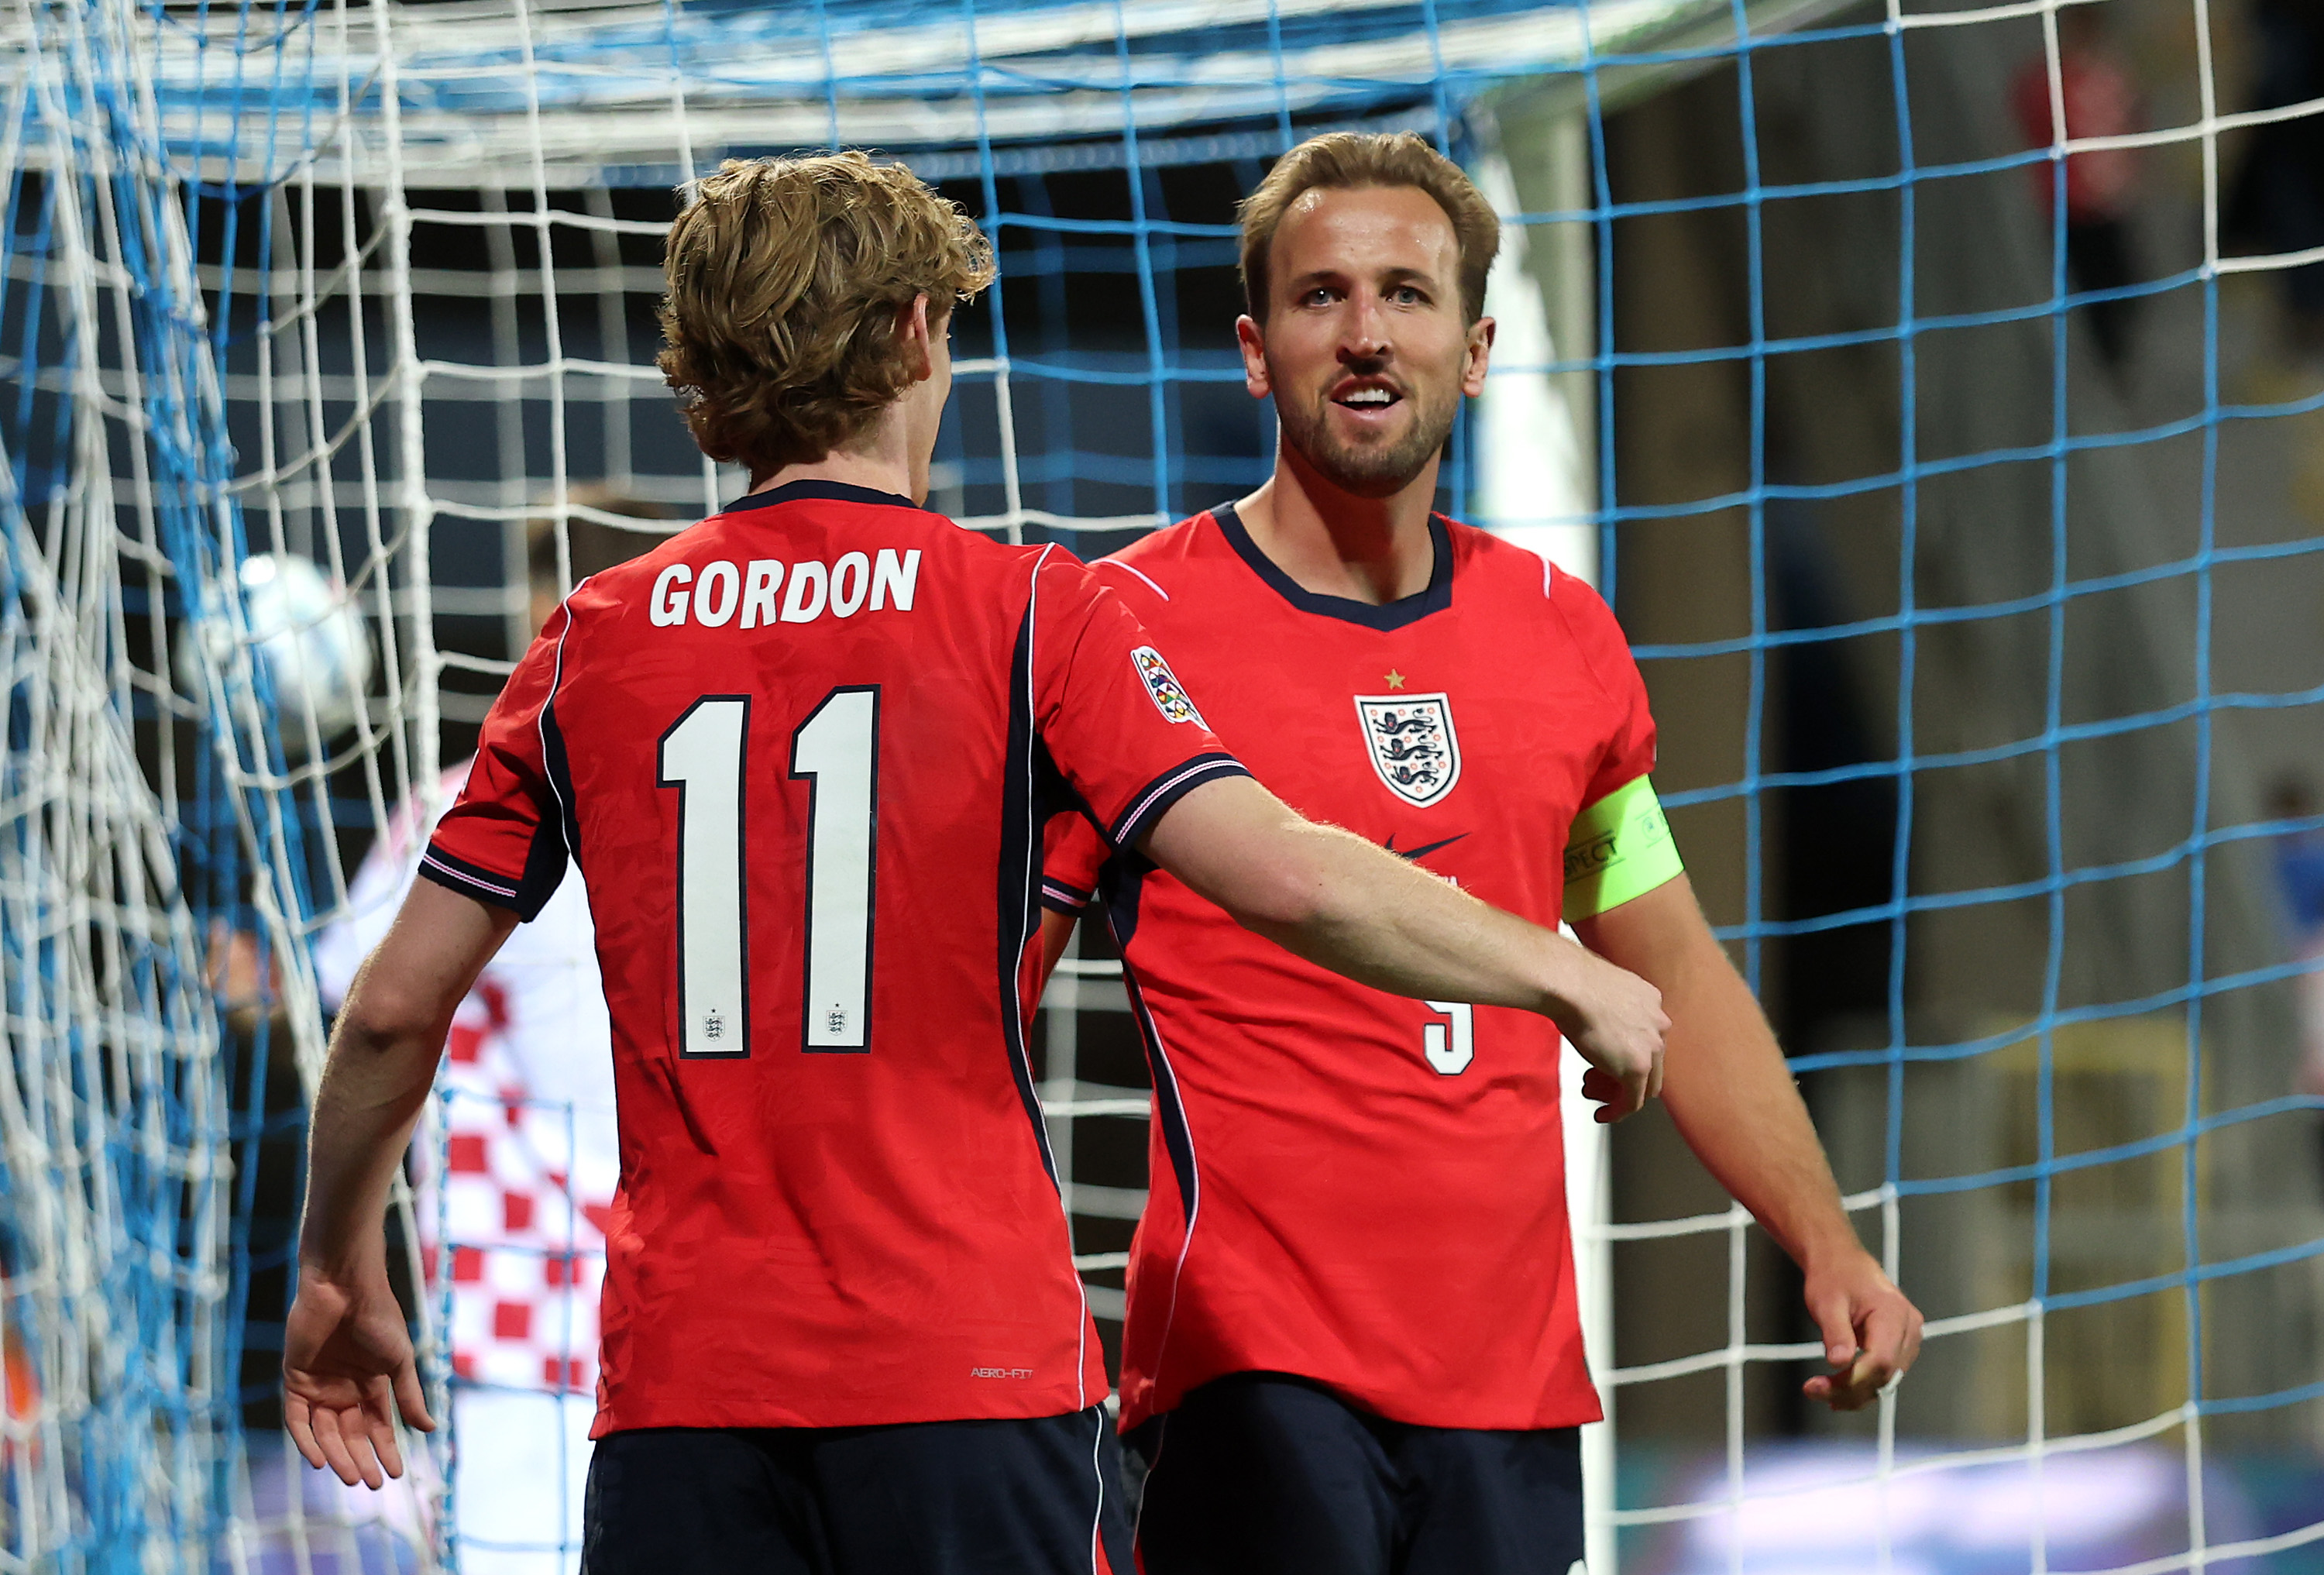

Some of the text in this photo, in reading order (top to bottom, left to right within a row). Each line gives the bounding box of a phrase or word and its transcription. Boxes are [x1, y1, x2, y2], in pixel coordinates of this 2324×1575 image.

[649, 548, 922, 629] GORDON
[656, 683, 881, 1059] 11
[970, 1367, 1033, 1379] AERO-FIT
